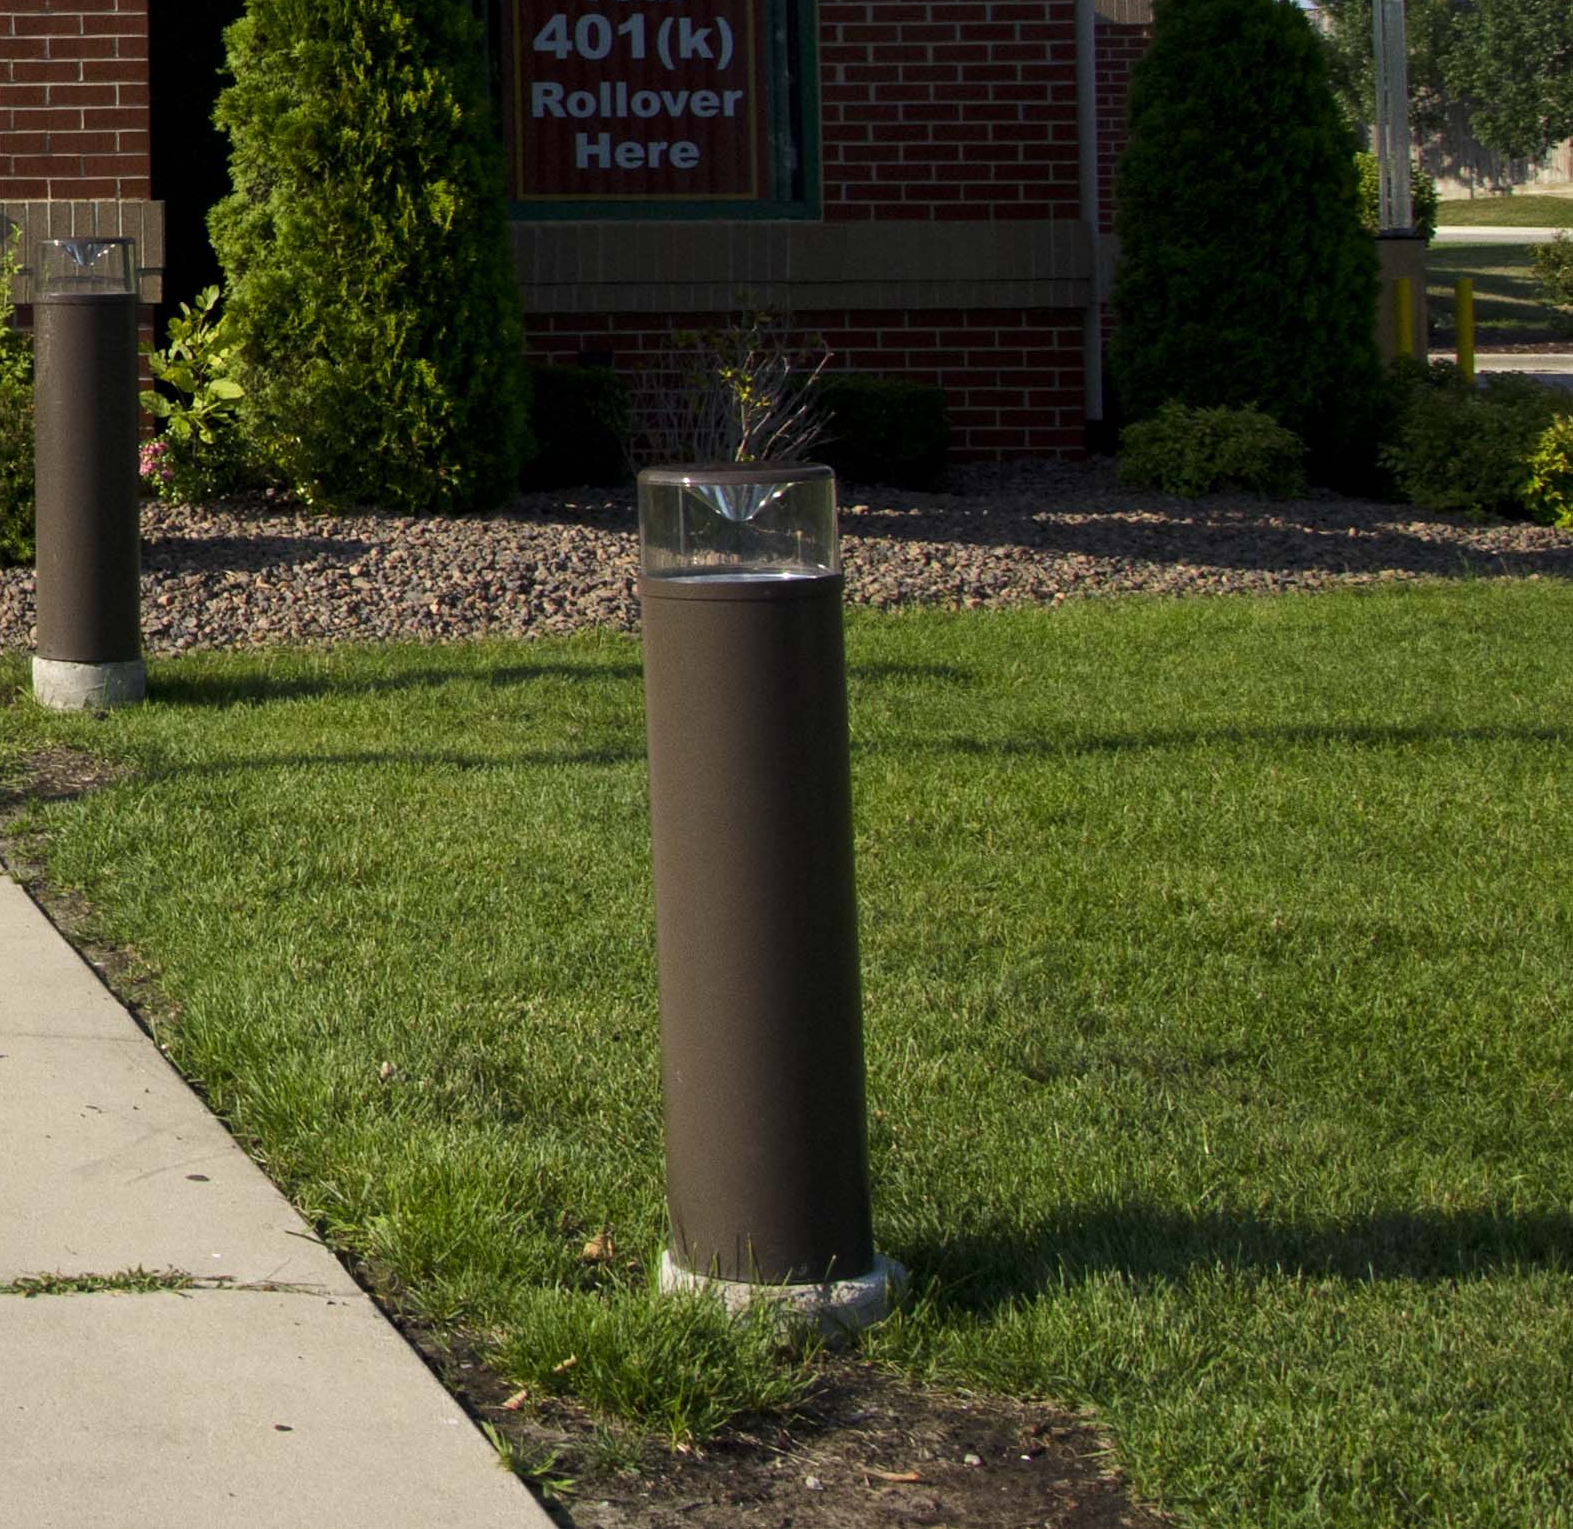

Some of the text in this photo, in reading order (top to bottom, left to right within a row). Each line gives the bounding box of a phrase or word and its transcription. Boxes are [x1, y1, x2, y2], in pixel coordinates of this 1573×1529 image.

[533, 13, 735, 70] 401(k)
[532, 81, 744, 118] Rollover
[575, 133, 702, 169] Here
